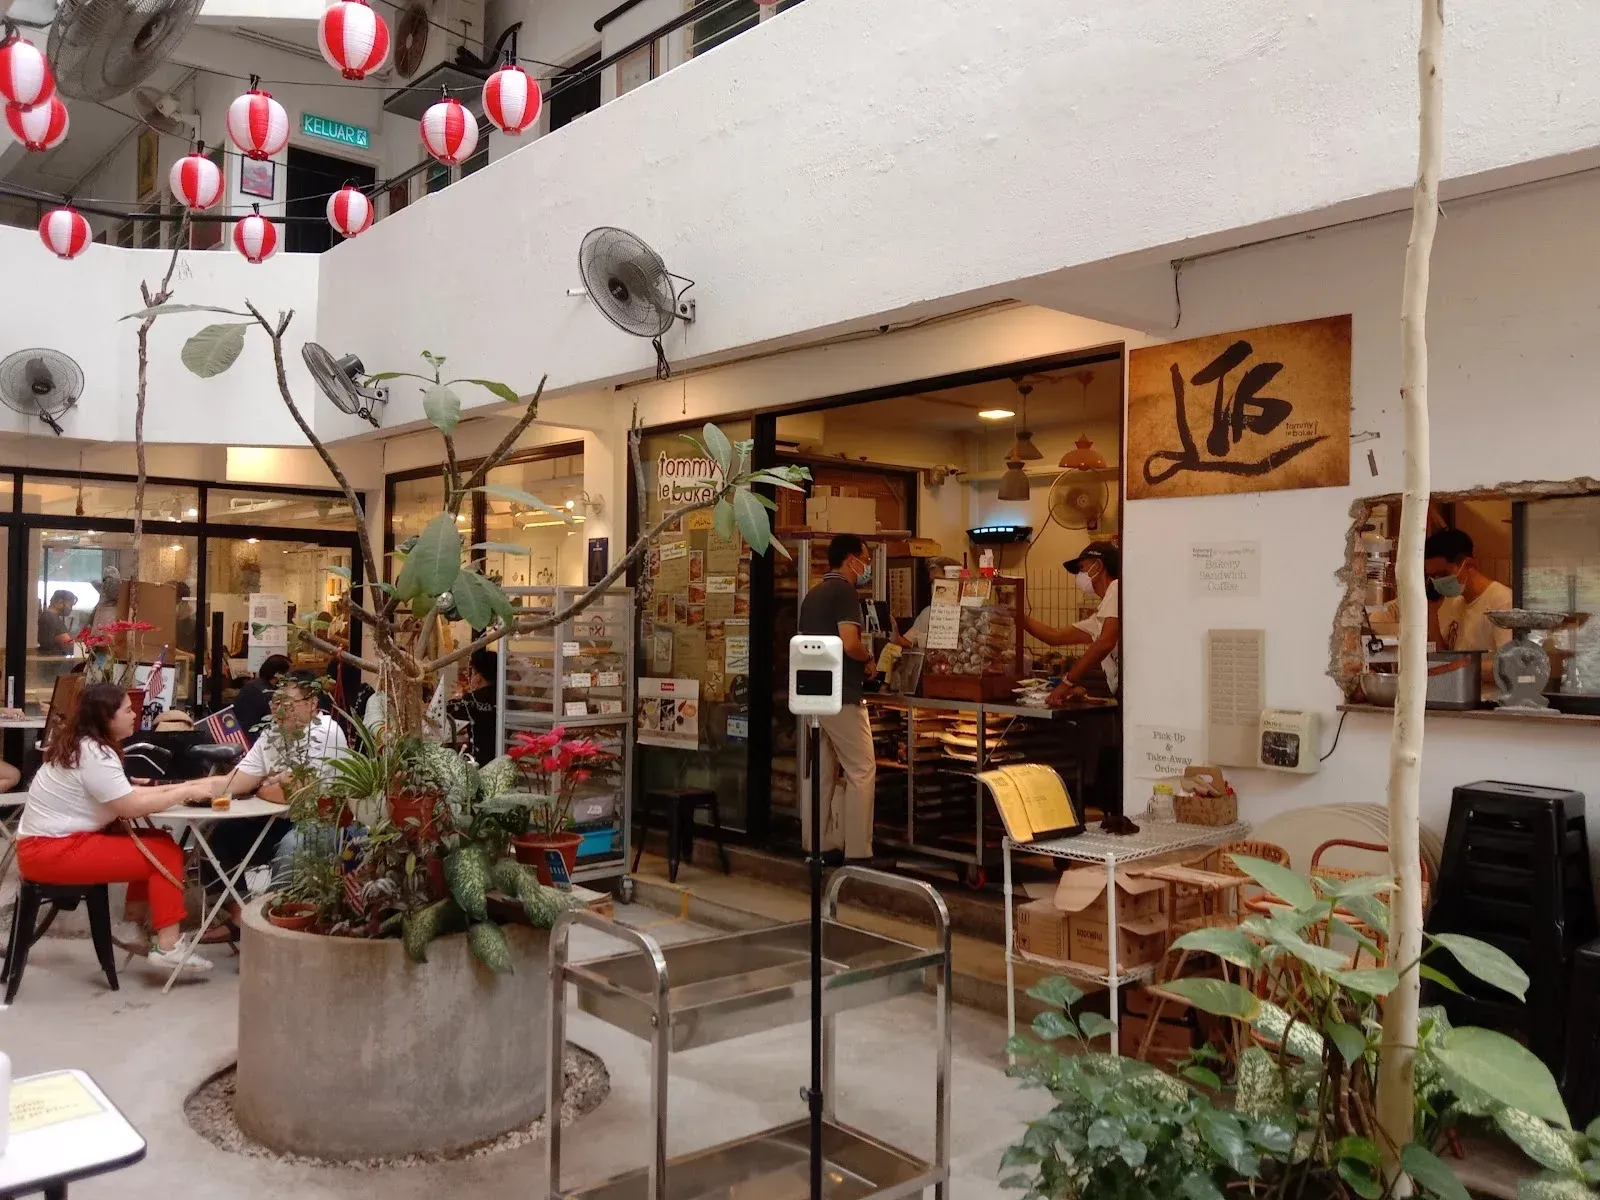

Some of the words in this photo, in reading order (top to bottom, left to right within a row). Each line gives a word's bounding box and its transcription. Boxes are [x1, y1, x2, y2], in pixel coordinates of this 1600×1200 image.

[304, 115, 355, 142] KELUAR
[1285, 421, 1314, 430] tommy
[658, 453, 718, 479] tommy
[658, 483, 670, 499] le
[1205, 559, 1241, 570] Bakery
[1199, 569, 1248, 580] Sandwich
[1207, 580, 1238, 591] Coffee
[1152, 730, 1186, 743] Pick-Up
[1165, 743, 1174, 752] &
[1146, 752, 1193, 765] Take-Away
[1154, 763, 1184, 775] Orders
